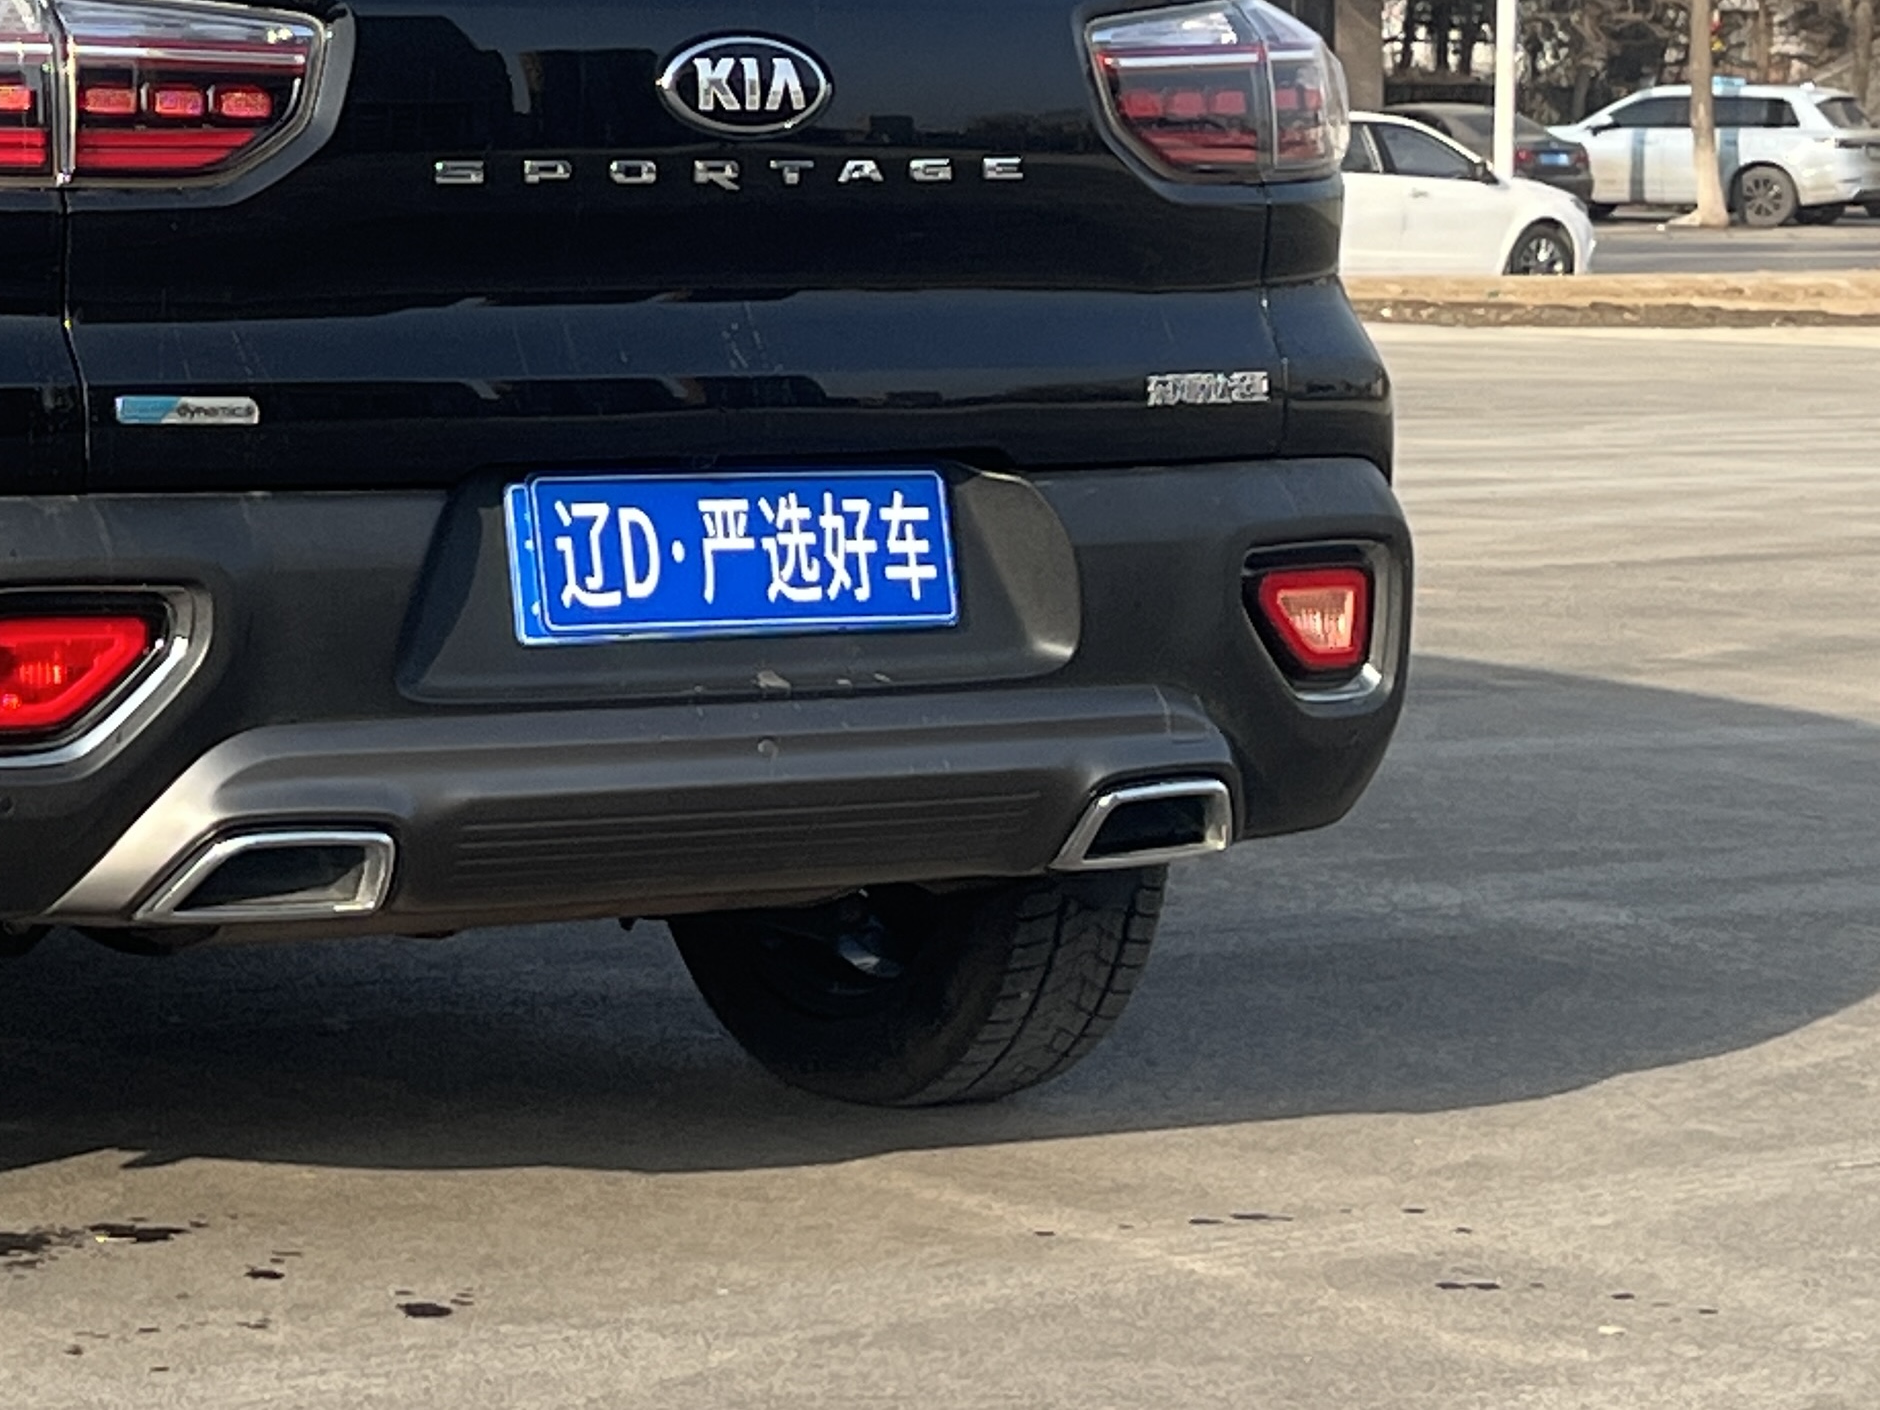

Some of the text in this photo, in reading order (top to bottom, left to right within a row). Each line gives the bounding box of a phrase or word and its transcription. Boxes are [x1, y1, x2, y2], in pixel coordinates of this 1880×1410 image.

[694, 57, 806, 111] KIA
[434, 156, 1024, 190] SPORTAGE
[554, 490, 938, 609] 辽D·严选好车
